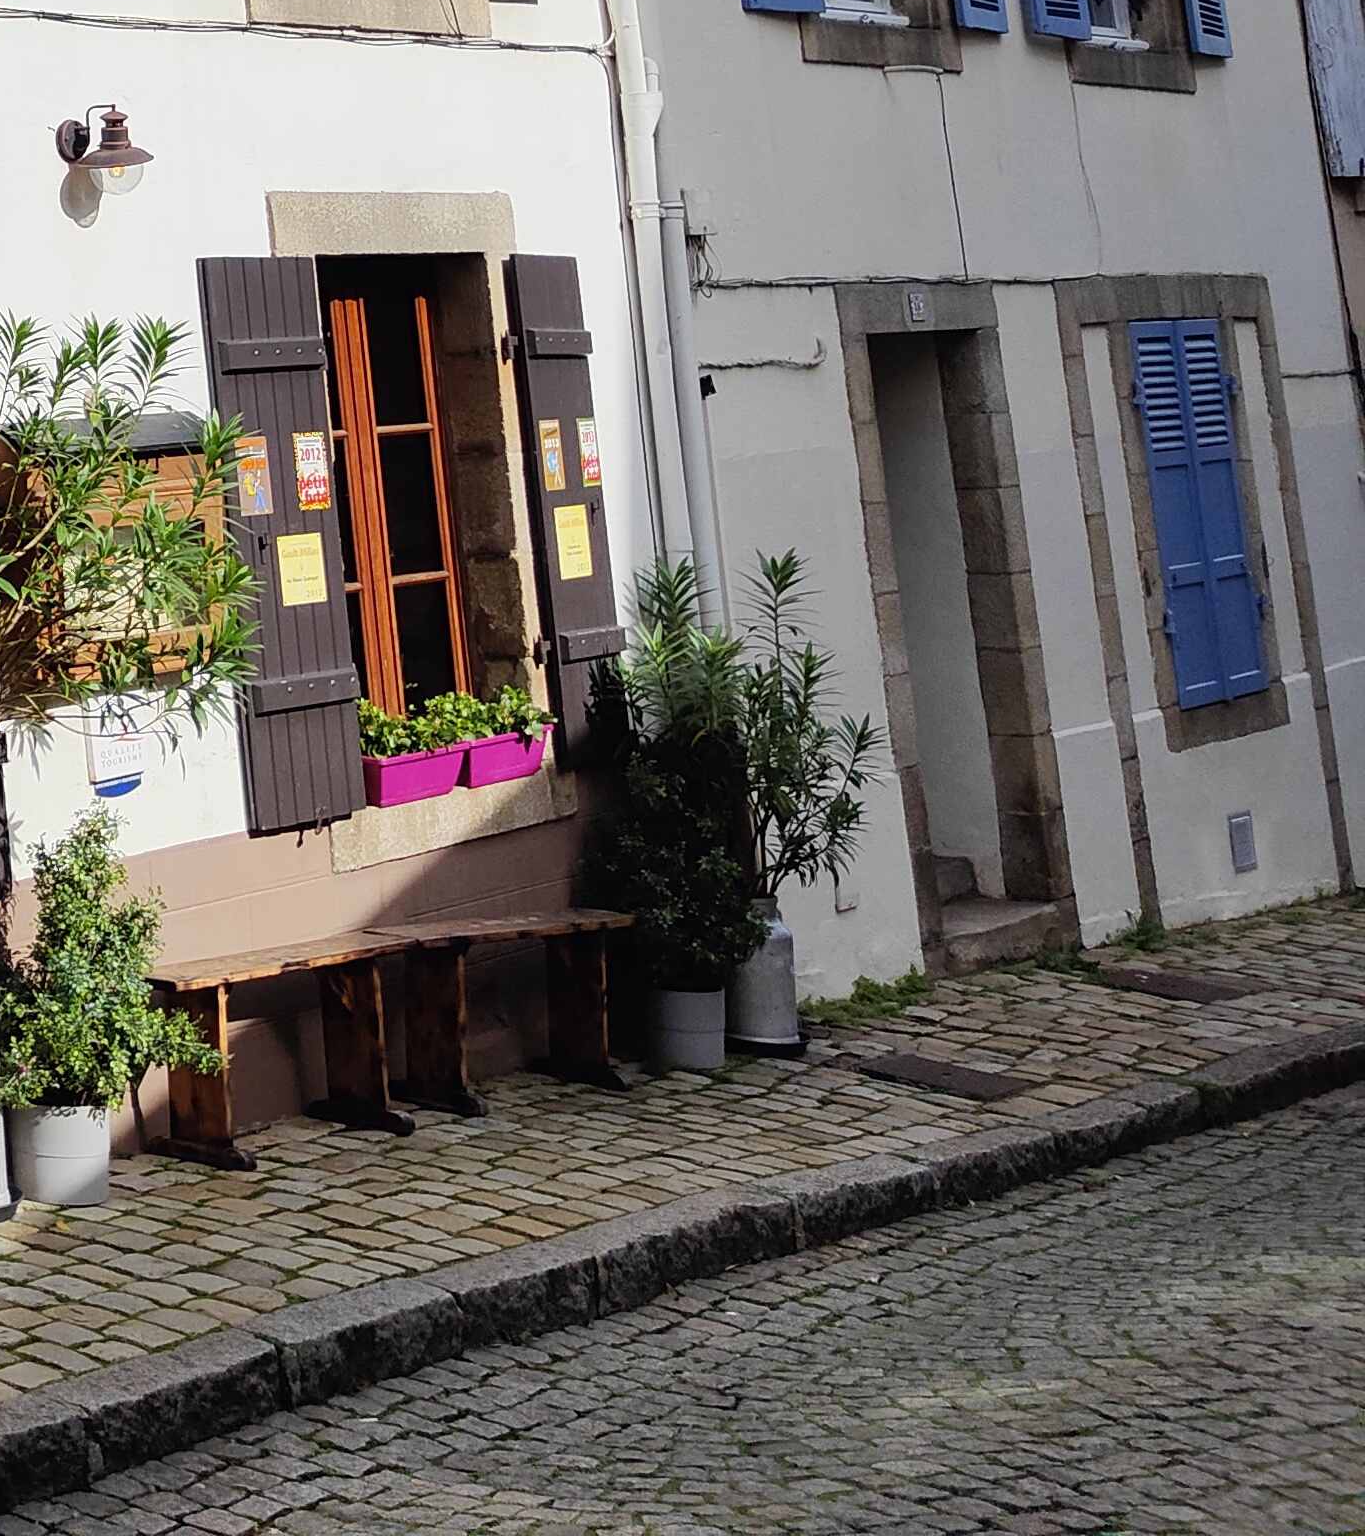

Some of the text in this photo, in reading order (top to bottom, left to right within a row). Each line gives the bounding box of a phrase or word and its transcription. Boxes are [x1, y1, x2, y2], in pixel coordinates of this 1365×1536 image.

[544, 438, 560, 449] 2013
[581, 431, 595, 444] 2013
[300, 447, 321, 461] 2012
[241, 458, 266, 470] 2012
[102, 753, 142, 768] TOURISME
